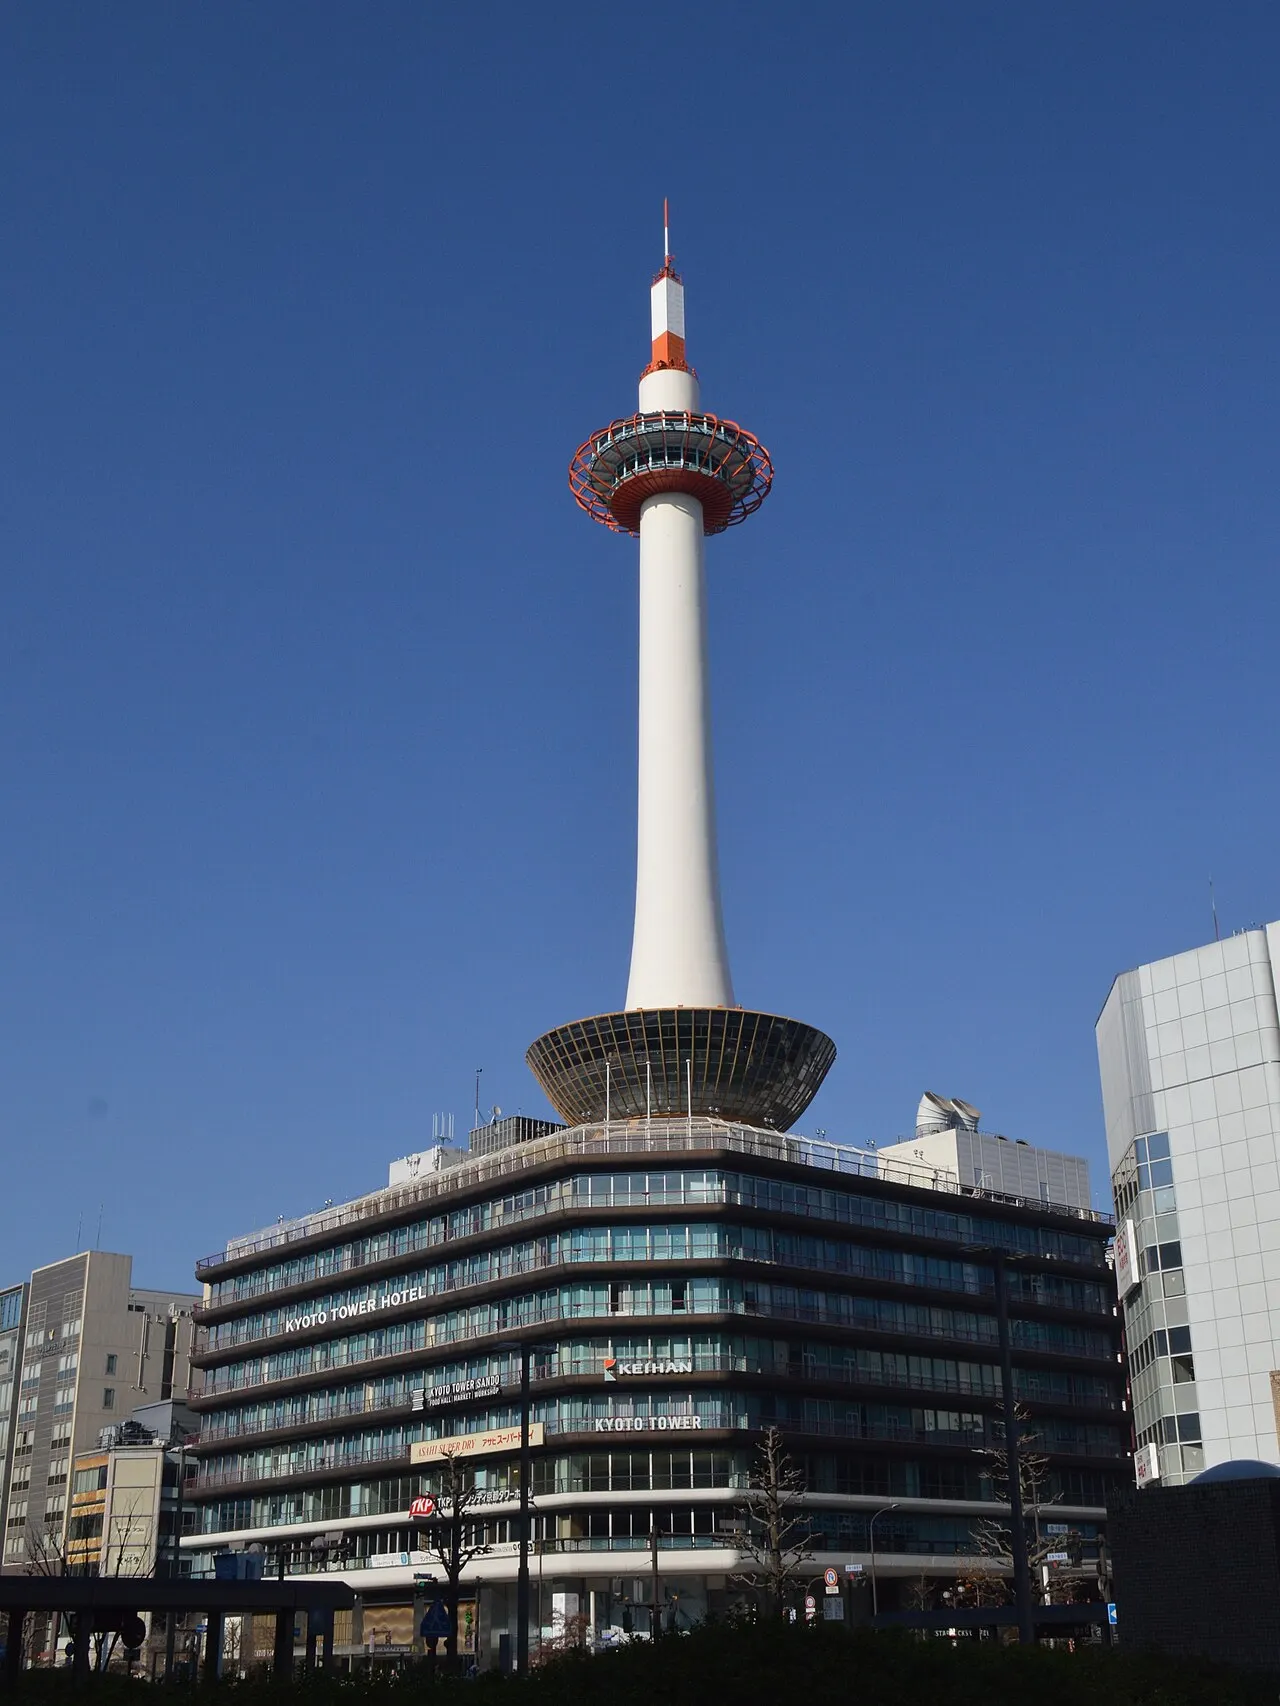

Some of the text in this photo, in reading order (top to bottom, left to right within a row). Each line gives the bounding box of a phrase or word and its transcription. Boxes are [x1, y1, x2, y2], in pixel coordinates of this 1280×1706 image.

[286, 1286, 427, 1333] KYOTO TOWER HOTEL
[618, 1361, 692, 1374] KEIHAN
[430, 1374, 500, 1397] KYOTO TOWER SANDO
[429, 1387, 499, 1406] FOOD HALL MARKET WORKSHOP
[595, 1415, 702, 1432] KYOTO TOWER
[417, 1439, 477, 1457] ASAHI SUPER DRY
[411, 1497, 433, 1513] TKP
[934, 1629, 969, 1637] STACKS
